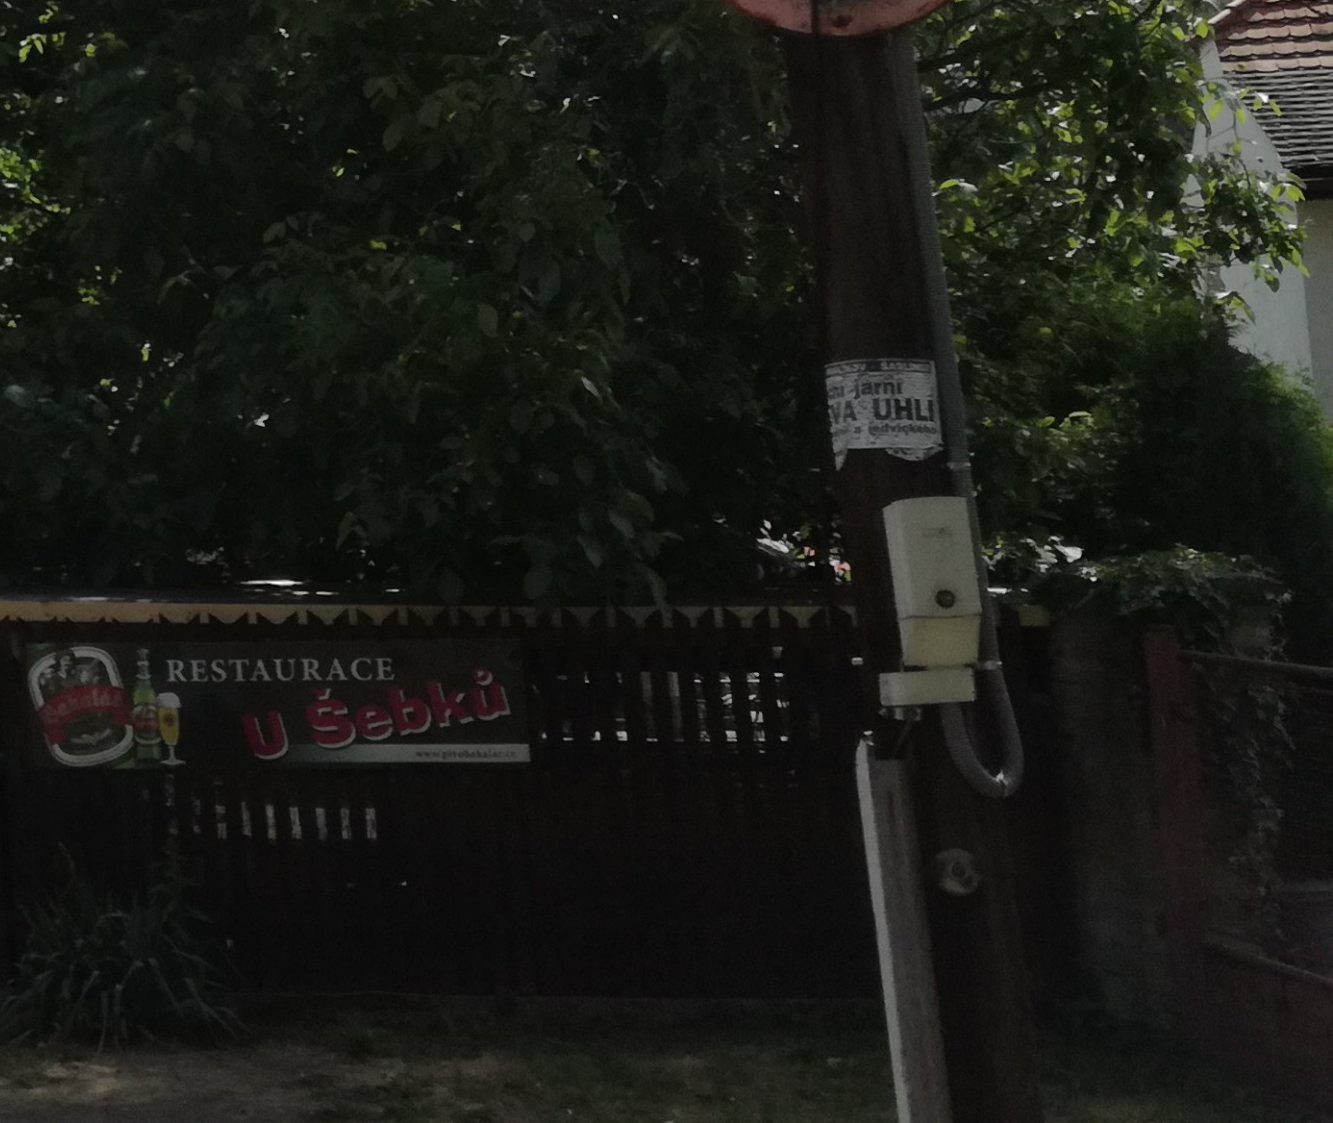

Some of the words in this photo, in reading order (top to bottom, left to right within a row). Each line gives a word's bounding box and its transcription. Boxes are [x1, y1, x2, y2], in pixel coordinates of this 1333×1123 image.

[166, 657, 395, 683] RESTAURACE
[241, 709, 290, 760] U
[305, 668, 512, 750] Šebků
